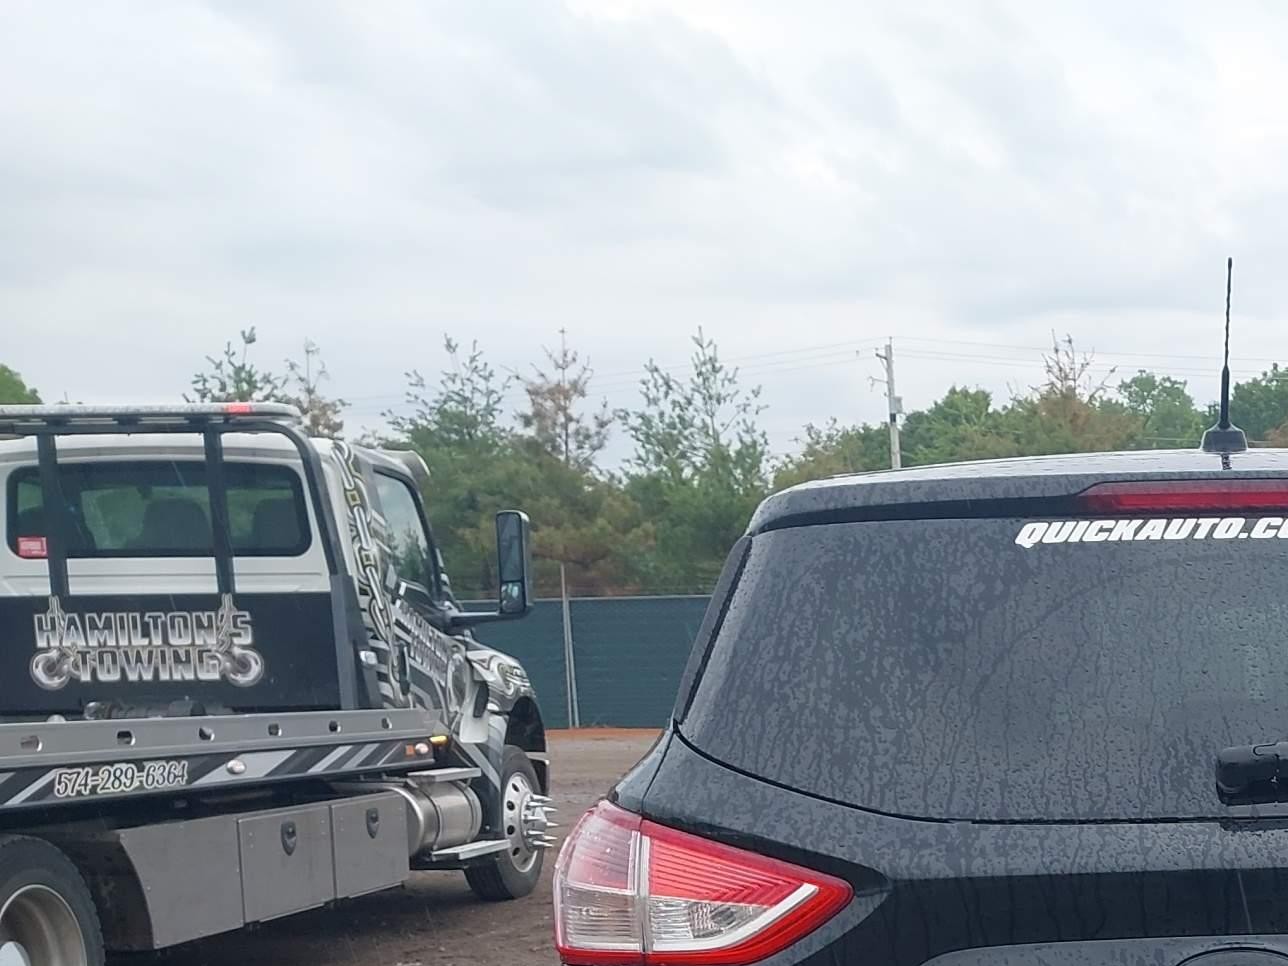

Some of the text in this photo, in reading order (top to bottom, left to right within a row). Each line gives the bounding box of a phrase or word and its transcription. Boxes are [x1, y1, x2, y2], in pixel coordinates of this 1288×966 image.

[34, 611, 252, 648] HAMILTON'S
[76, 648, 221, 682] TOWING
[55, 760, 188, 797] 574-289-6364
